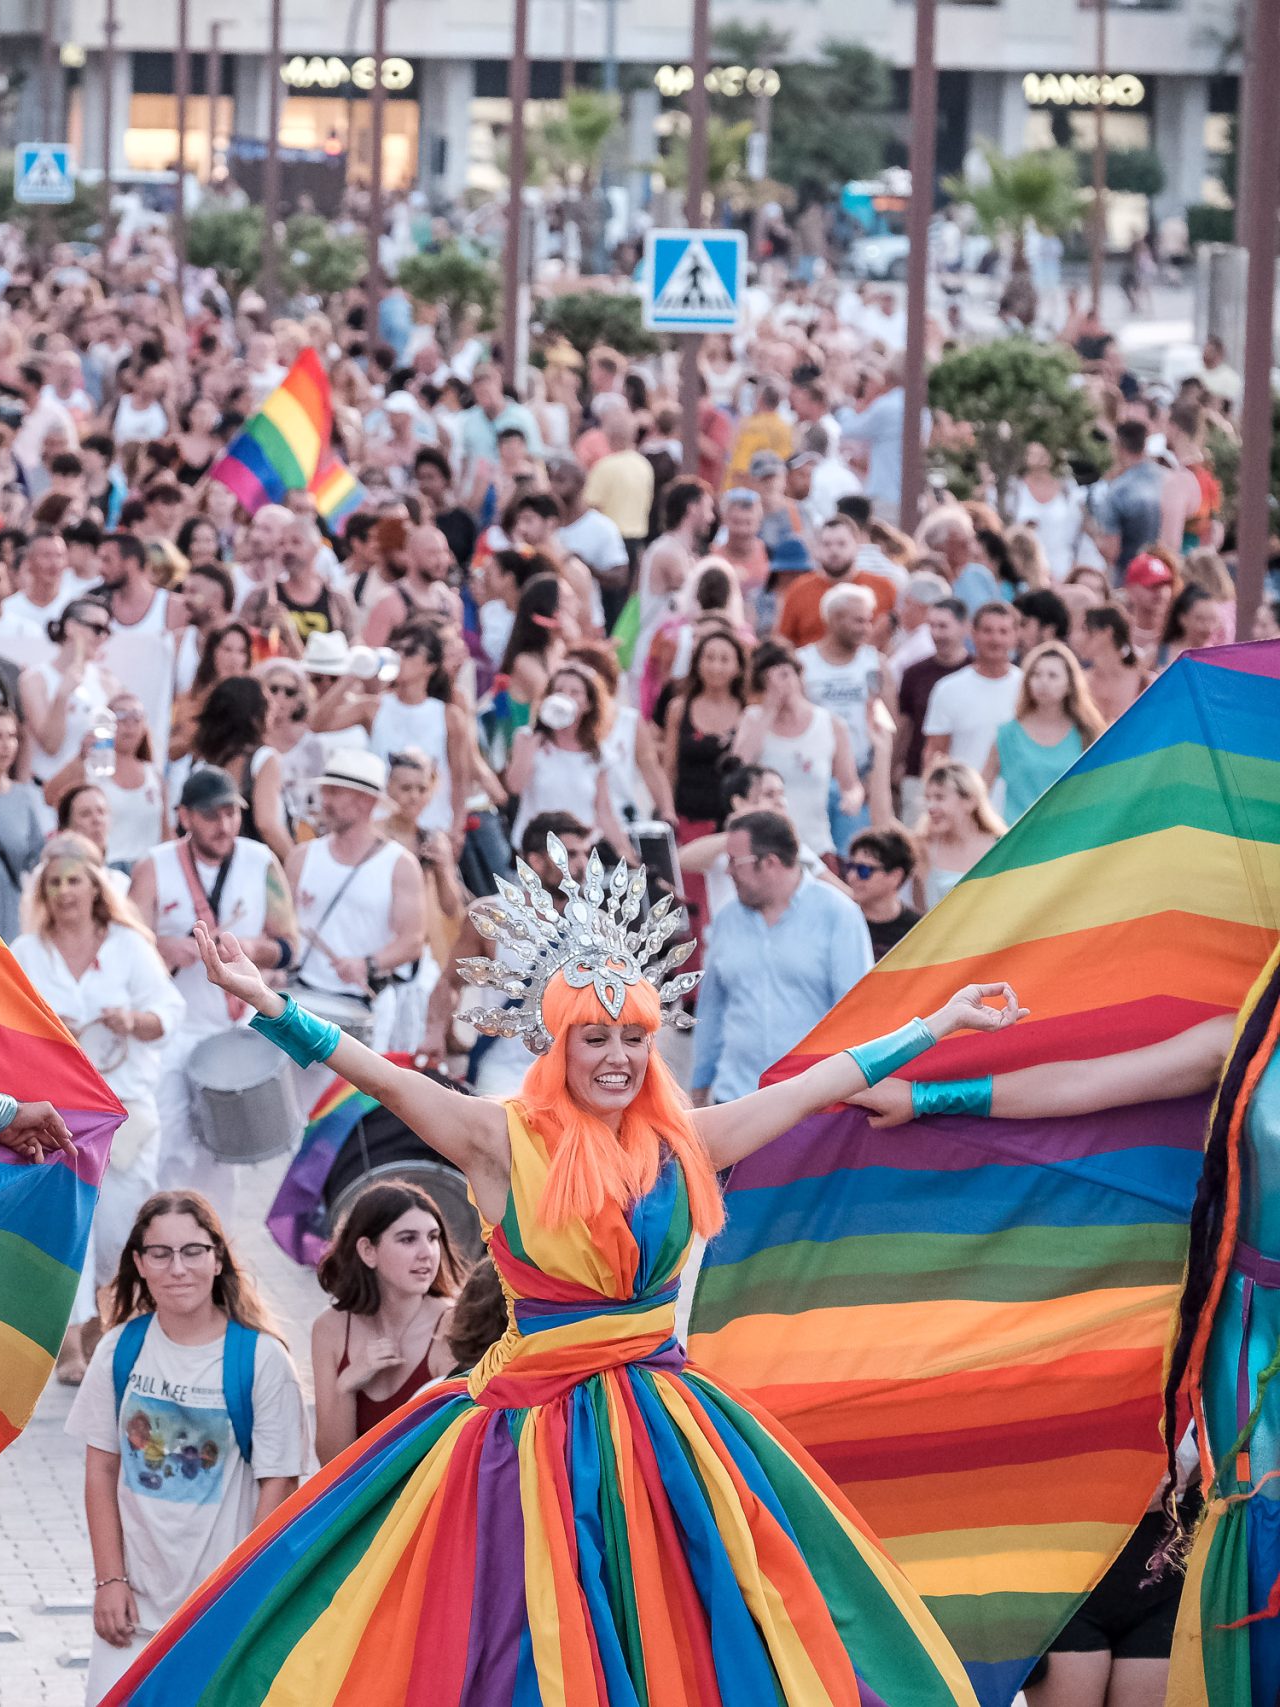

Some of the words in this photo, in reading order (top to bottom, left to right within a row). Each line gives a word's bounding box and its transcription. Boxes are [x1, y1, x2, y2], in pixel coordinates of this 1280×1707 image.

[280, 56, 414, 90] MANGO
[654, 65, 781, 97] MAGO
[129, 1373, 155, 1394] PAUL
